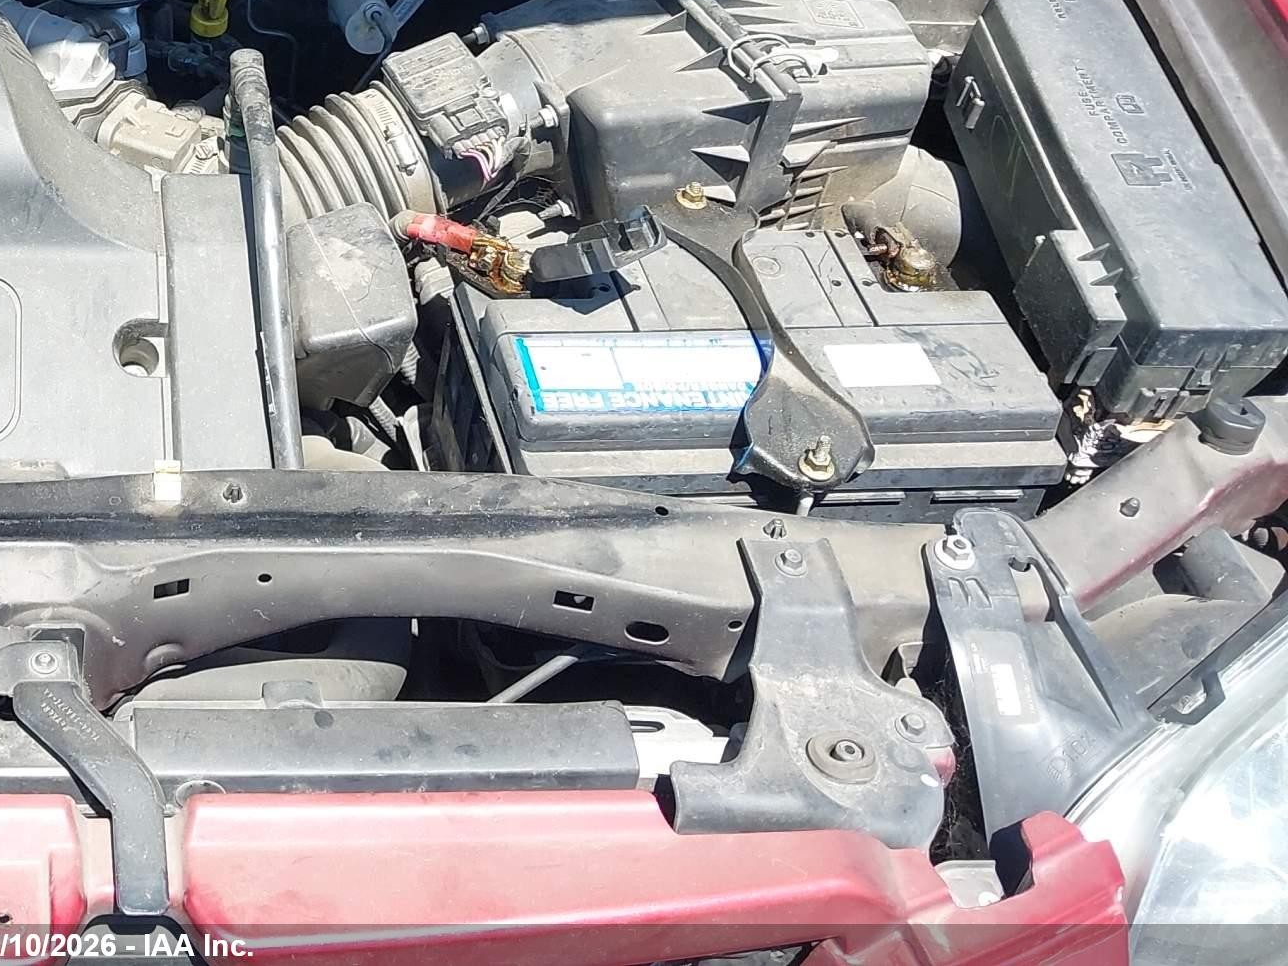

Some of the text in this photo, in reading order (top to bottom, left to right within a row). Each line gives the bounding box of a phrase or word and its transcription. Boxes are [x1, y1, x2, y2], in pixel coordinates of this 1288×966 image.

[1074, 65, 1129, 145] COMPARTMENT
[1077, 90, 1100, 117] FUSE
[543, 391, 605, 410] FREE
